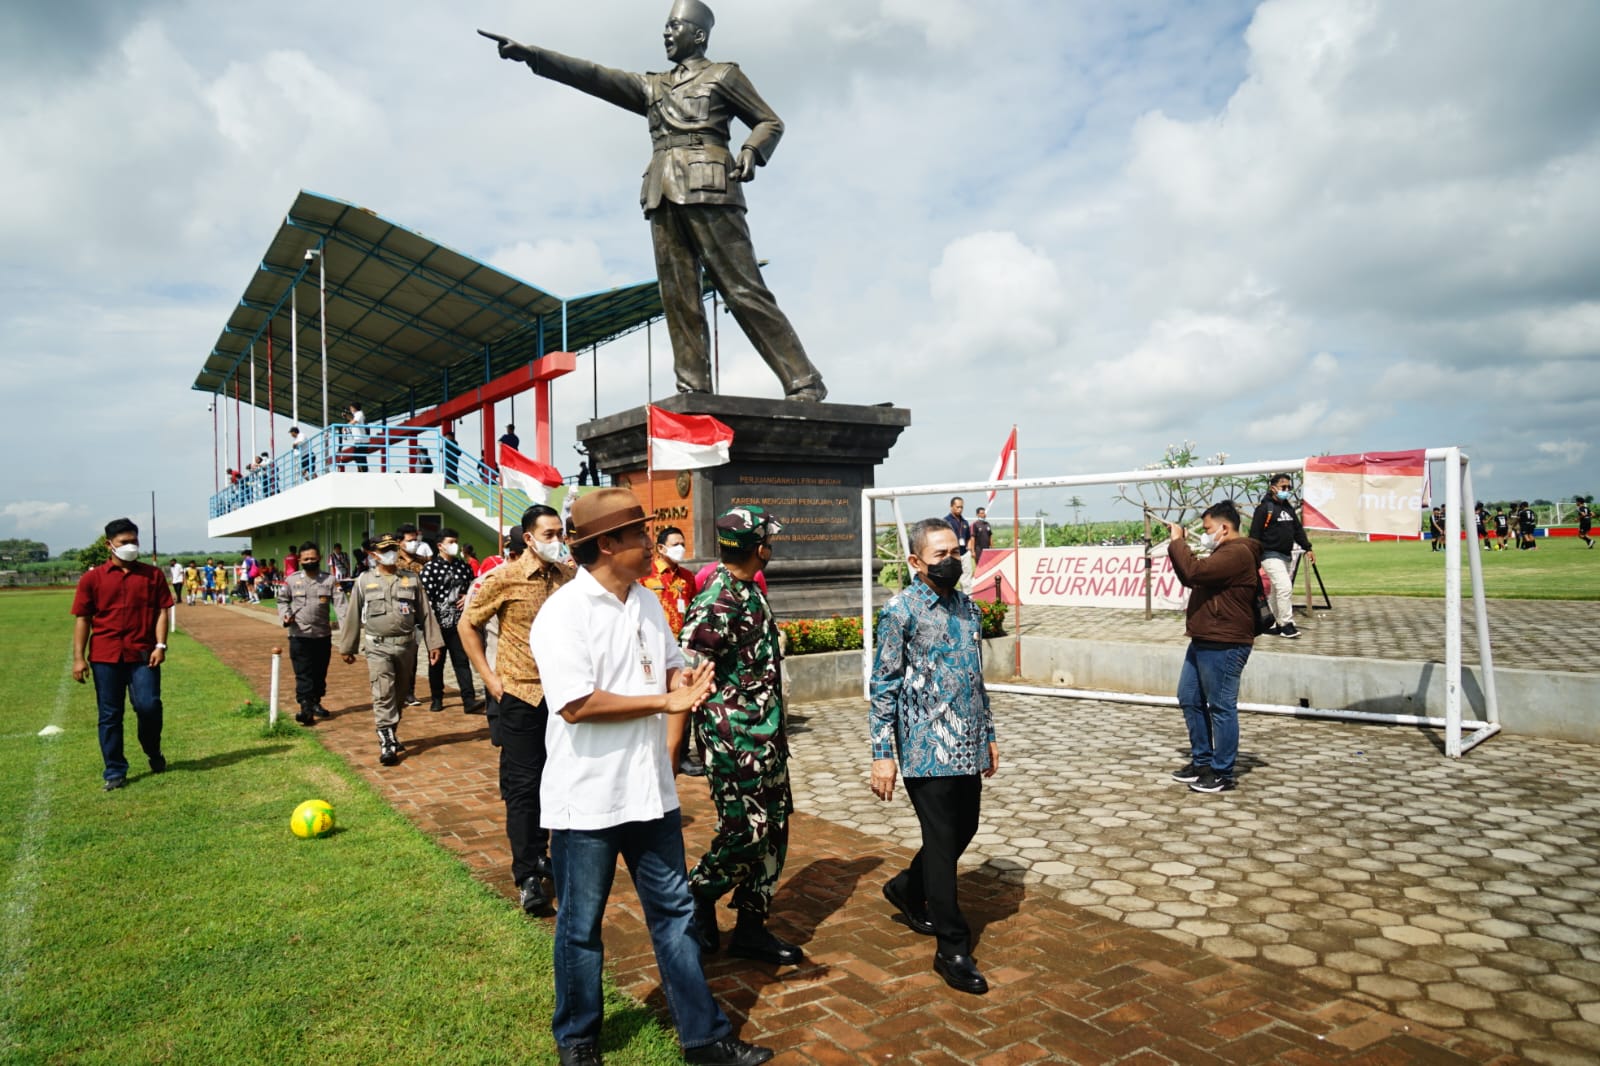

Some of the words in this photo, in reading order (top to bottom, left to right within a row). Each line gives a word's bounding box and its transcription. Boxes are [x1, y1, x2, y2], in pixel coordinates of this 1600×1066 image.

[731, 497, 760, 505] KARENA
[762, 497, 797, 505] MENGUSIR
[791, 533, 829, 542] BANGSAMU
[1036, 557, 1088, 574] ELITE
[1090, 556, 1173, 574] ACADEM
